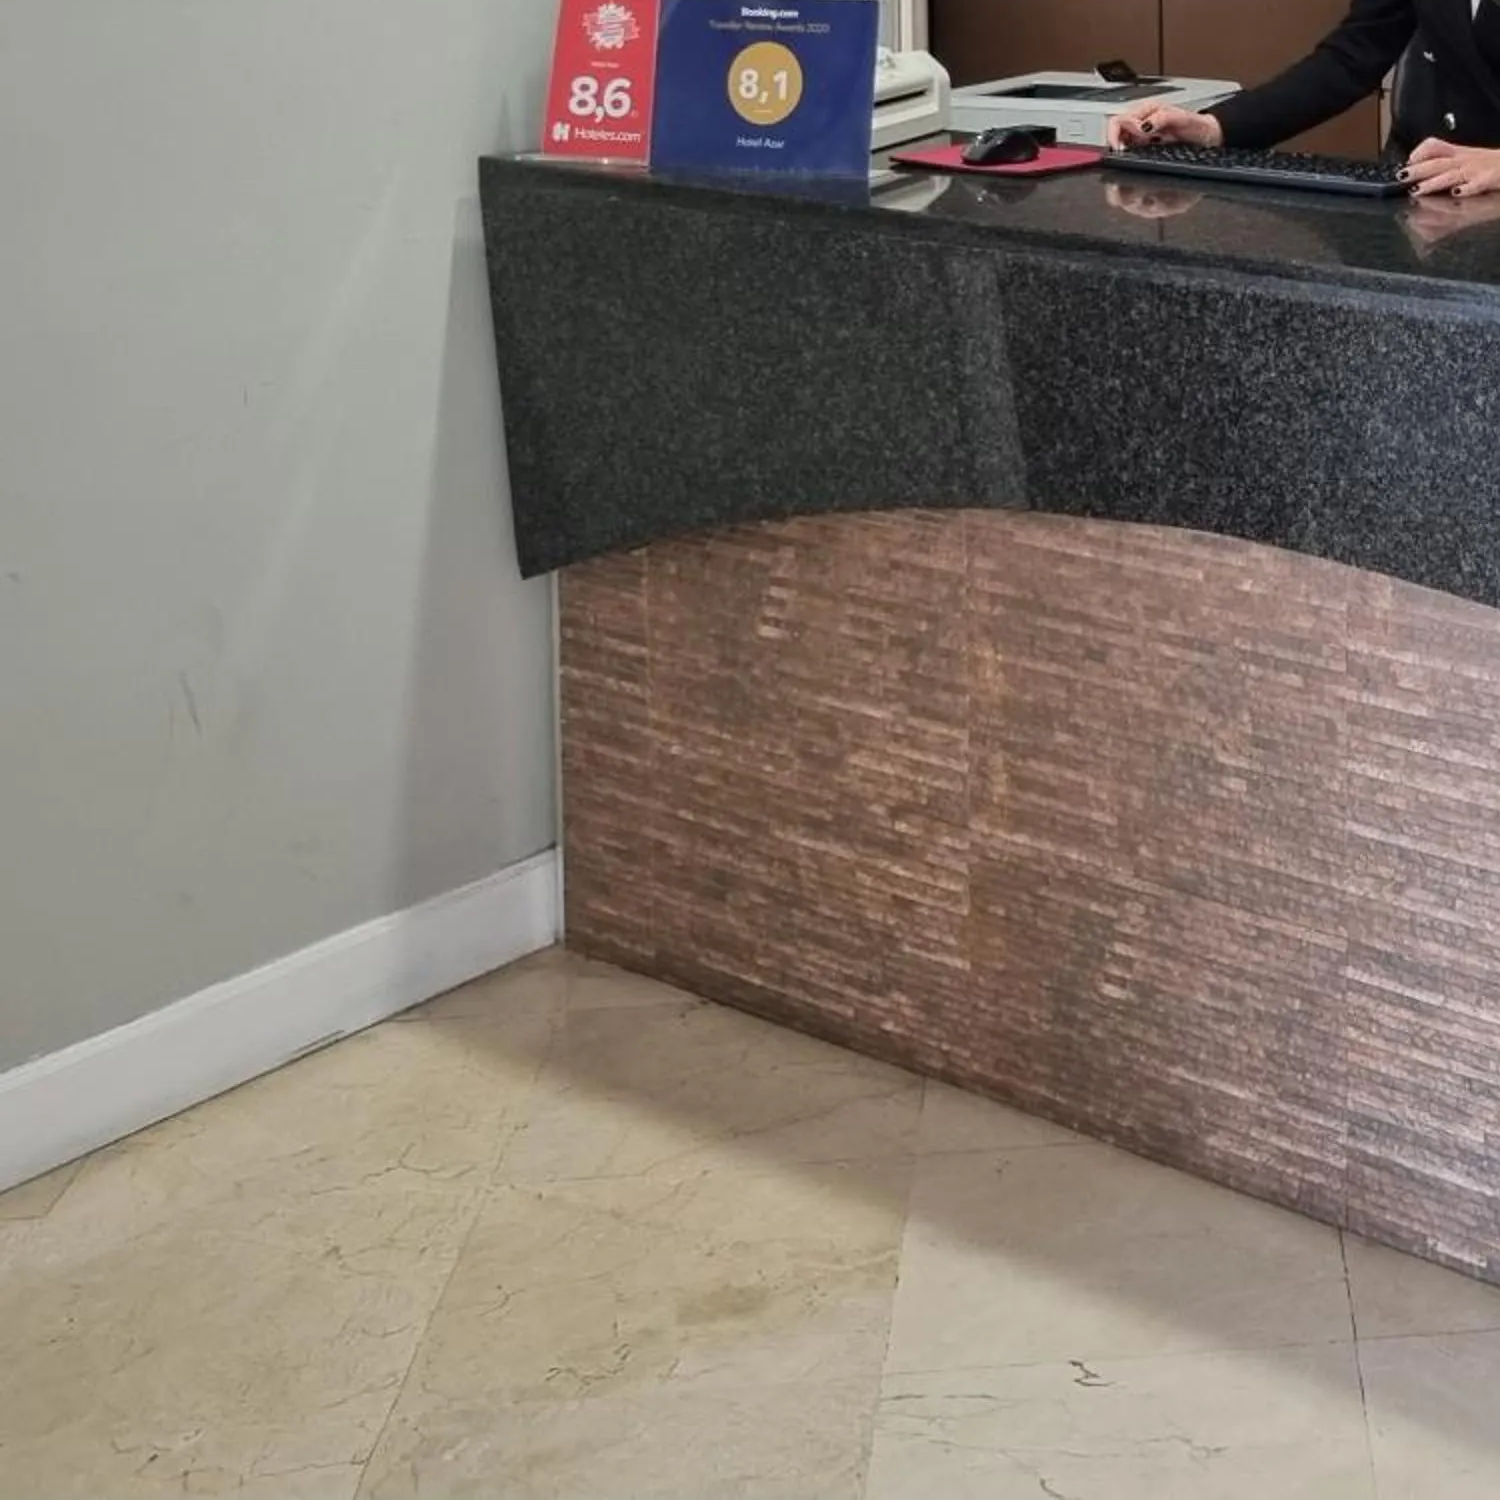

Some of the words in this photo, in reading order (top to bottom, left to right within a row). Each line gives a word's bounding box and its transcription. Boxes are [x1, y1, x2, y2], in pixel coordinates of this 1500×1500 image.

[568, 76, 632, 123] 8,6
[738, 68, 788, 105] 8,1
[574, 127, 641, 144] Hoteles.com
[736, 135, 762, 148] Hotel
